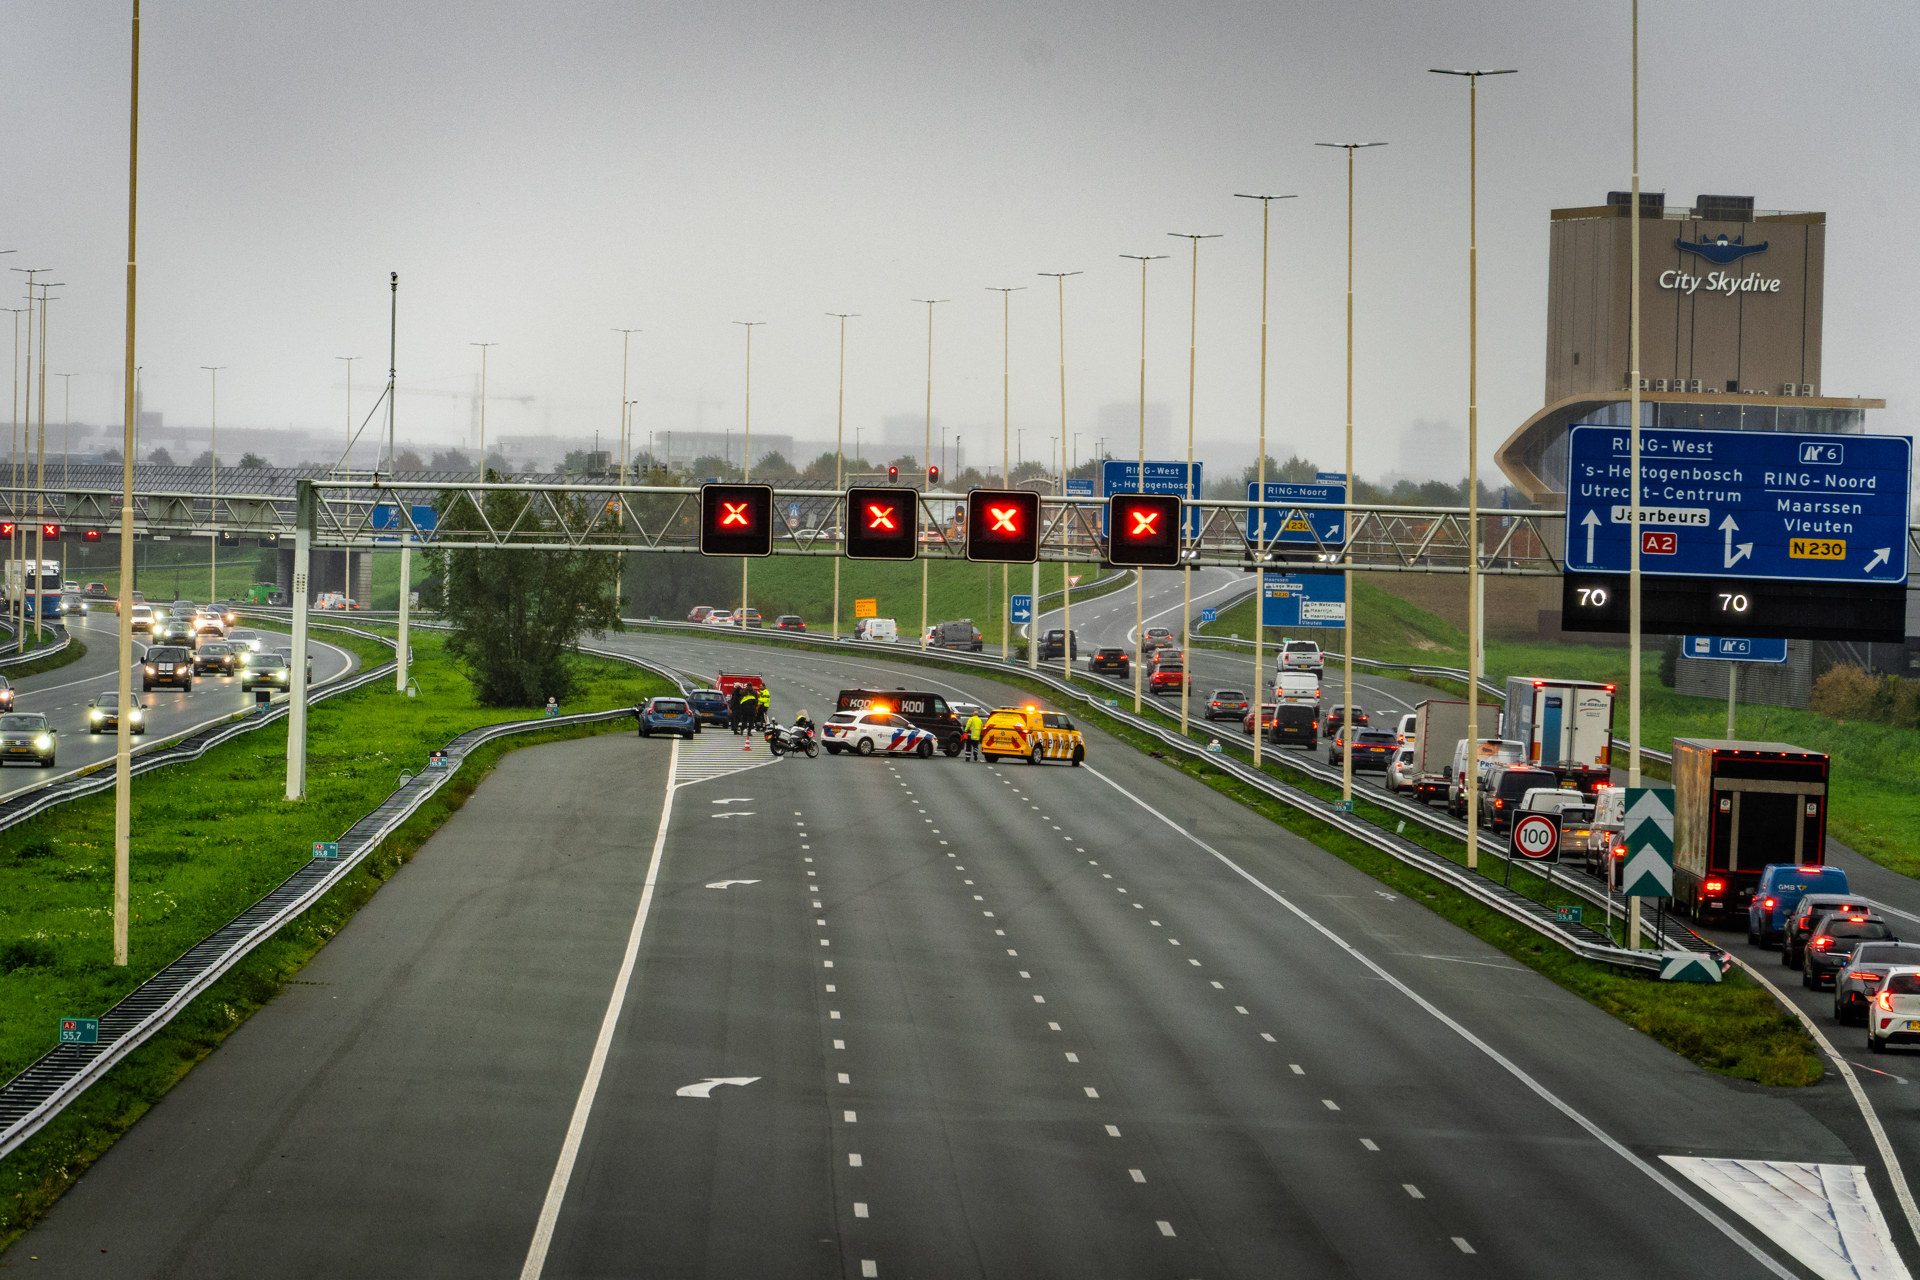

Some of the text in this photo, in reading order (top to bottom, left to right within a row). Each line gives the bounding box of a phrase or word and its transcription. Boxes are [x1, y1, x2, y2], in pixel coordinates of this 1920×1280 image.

[1659, 270, 1781, 296] City Skydive
[1827, 449, 1837, 460] 6
[1581, 463, 1743, 482] 's-Hetogenbosch
[1764, 472, 1876, 489] RING-Noord
[1110, 481, 1195, 490] 's-Heogenbosc
[1268, 487, 1327, 496] RING-Noord
[1581, 483, 1742, 502] Utrect-Centrum
[1278, 510, 1315, 519] Vluen
[1777, 498, 1862, 515] Maarssen
[1784, 518, 1853, 533] Vleuten
[1577, 588, 1607, 606] 70
[1719, 594, 1748, 612] 70
[1739, 643, 1746, 651] 6
[901, 700, 925, 713] KOOI
[1522, 828, 1549, 845] 100
